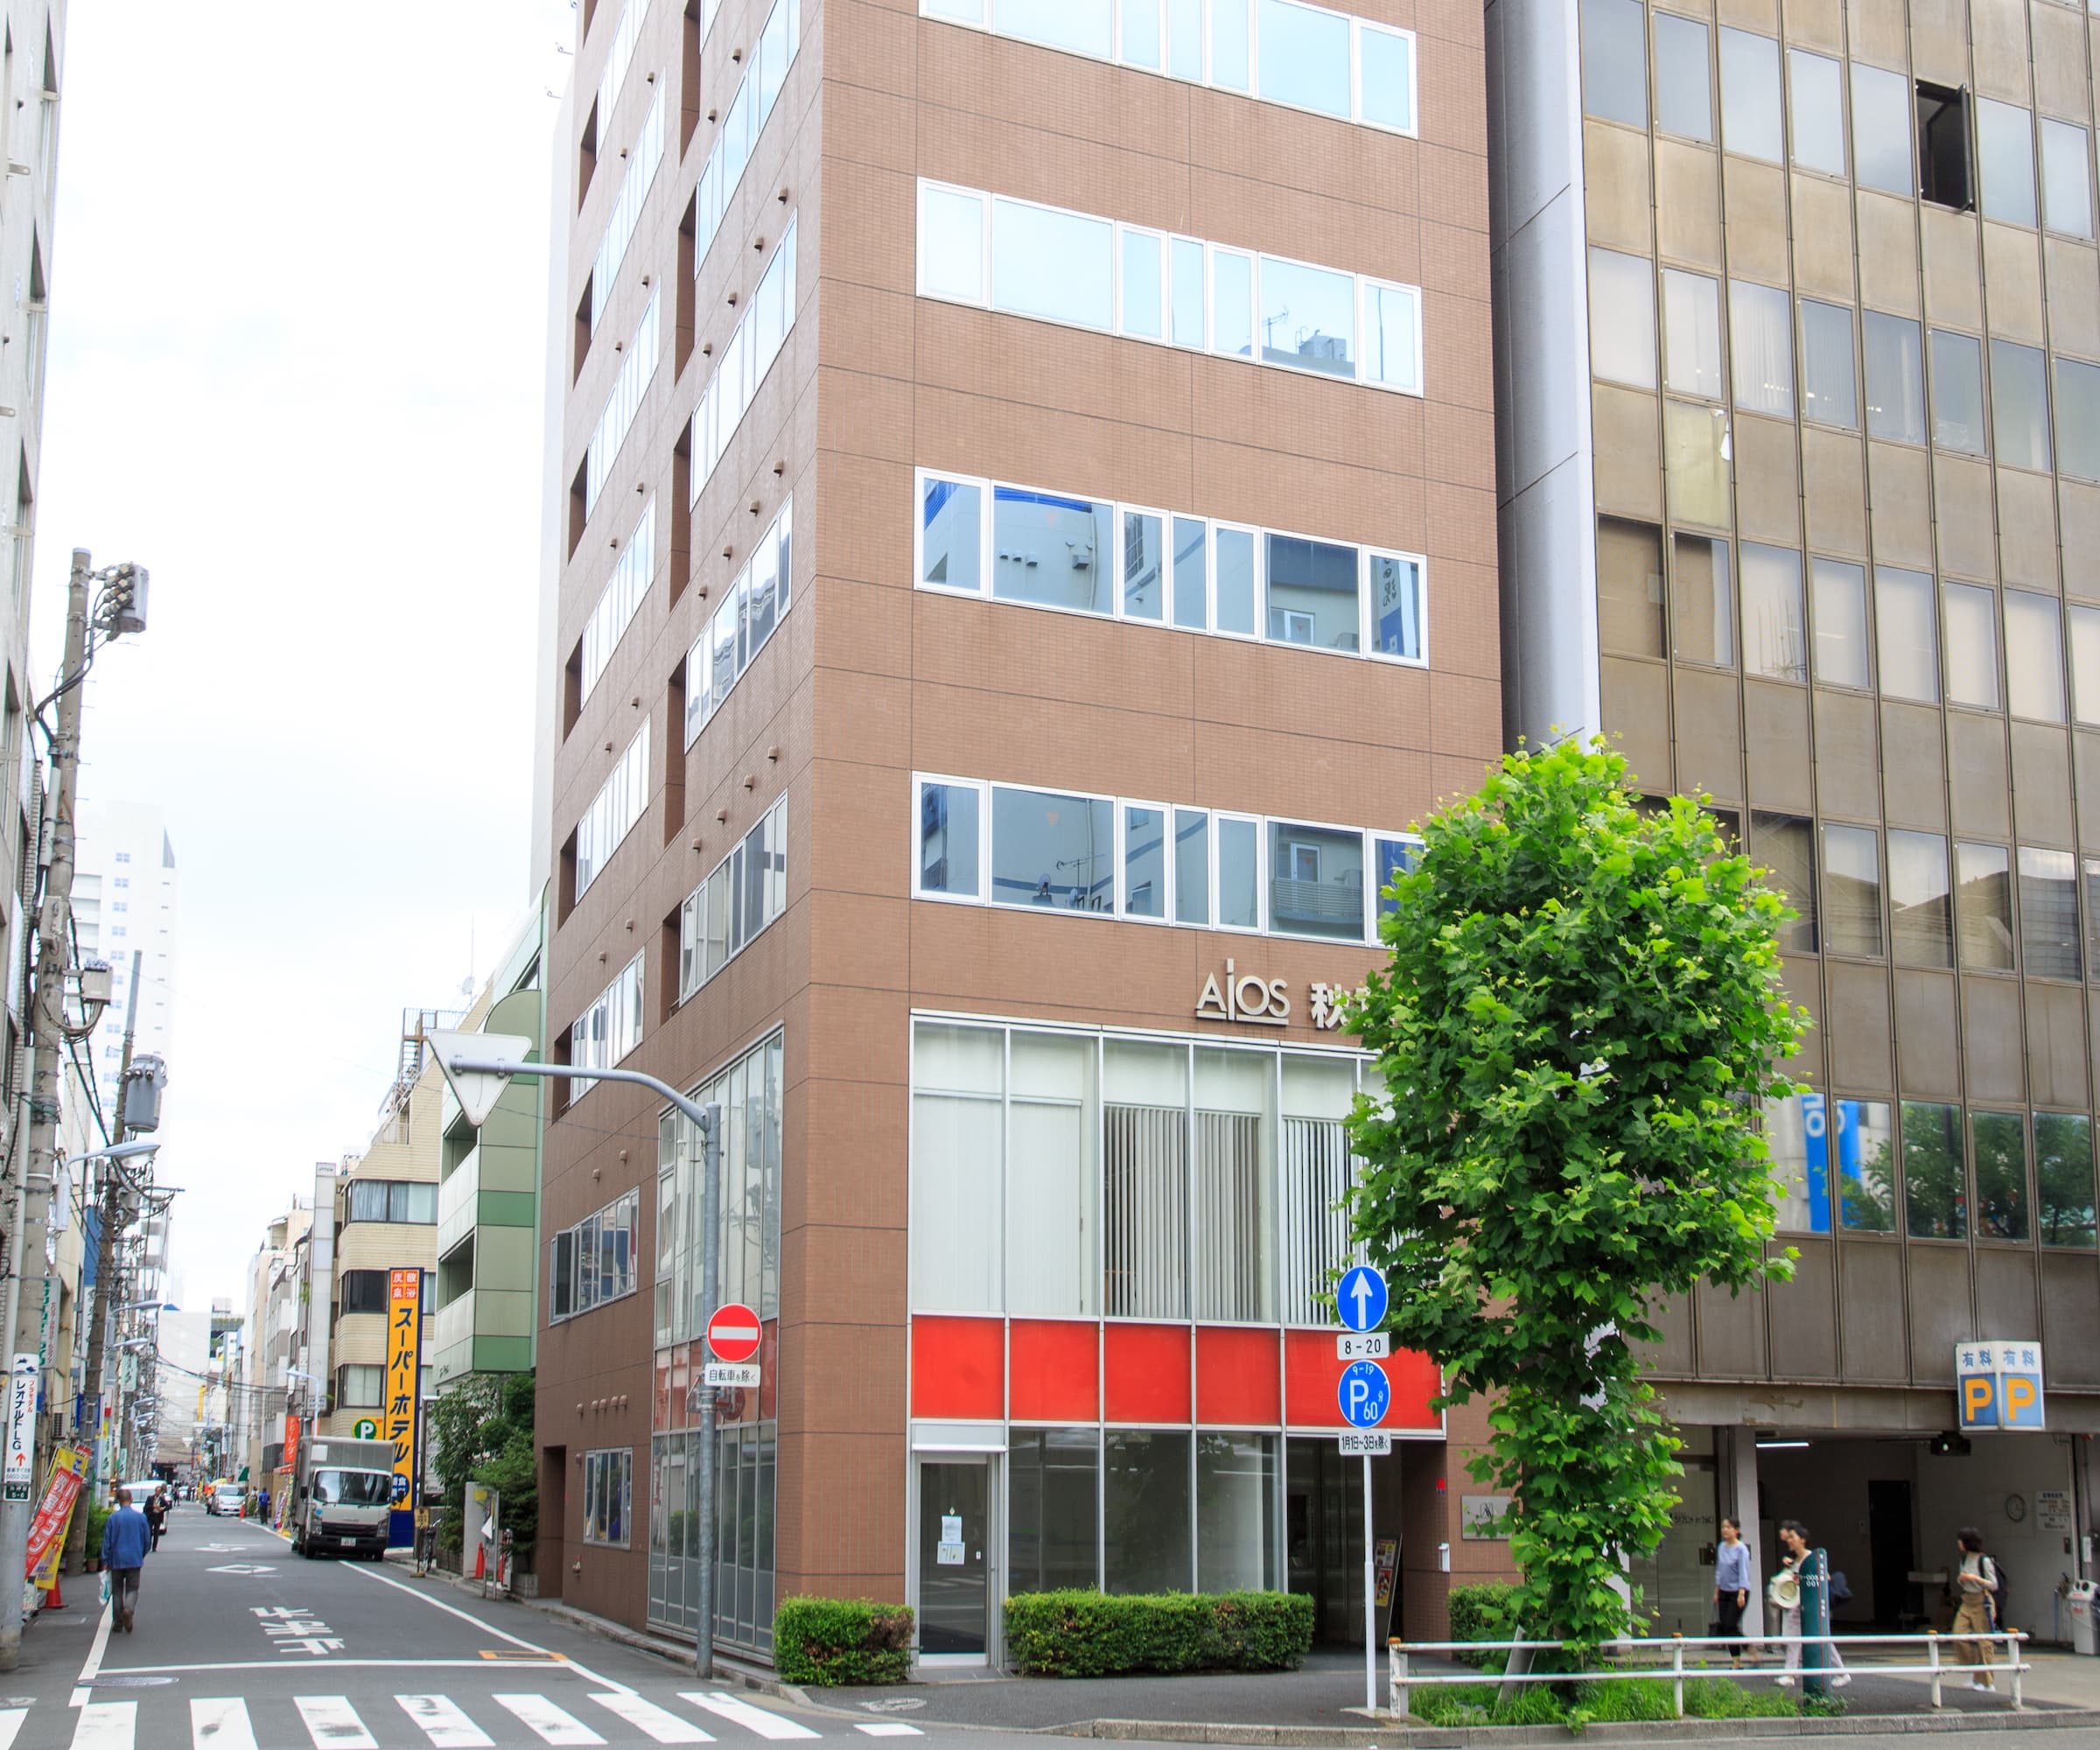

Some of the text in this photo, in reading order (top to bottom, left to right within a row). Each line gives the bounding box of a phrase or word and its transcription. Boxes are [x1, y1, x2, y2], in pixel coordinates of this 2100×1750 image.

[1344, 1339, 1381, 1355] 8-20
[1963, 1349, 1992, 1367] 有料
[2003, 1348, 2035, 1367] 有料
[709, 1368, 756, 1382] 自転車を除く
[1352, 1364, 1374, 1376] 9-19
[389, 1307, 413, 1464] スーパーホテル
[1349, 1379, 1369, 1421] P
[1965, 1378, 1992, 1422] P
[2006, 1378, 2035, 1421] P
[360, 1422, 374, 1439] P
